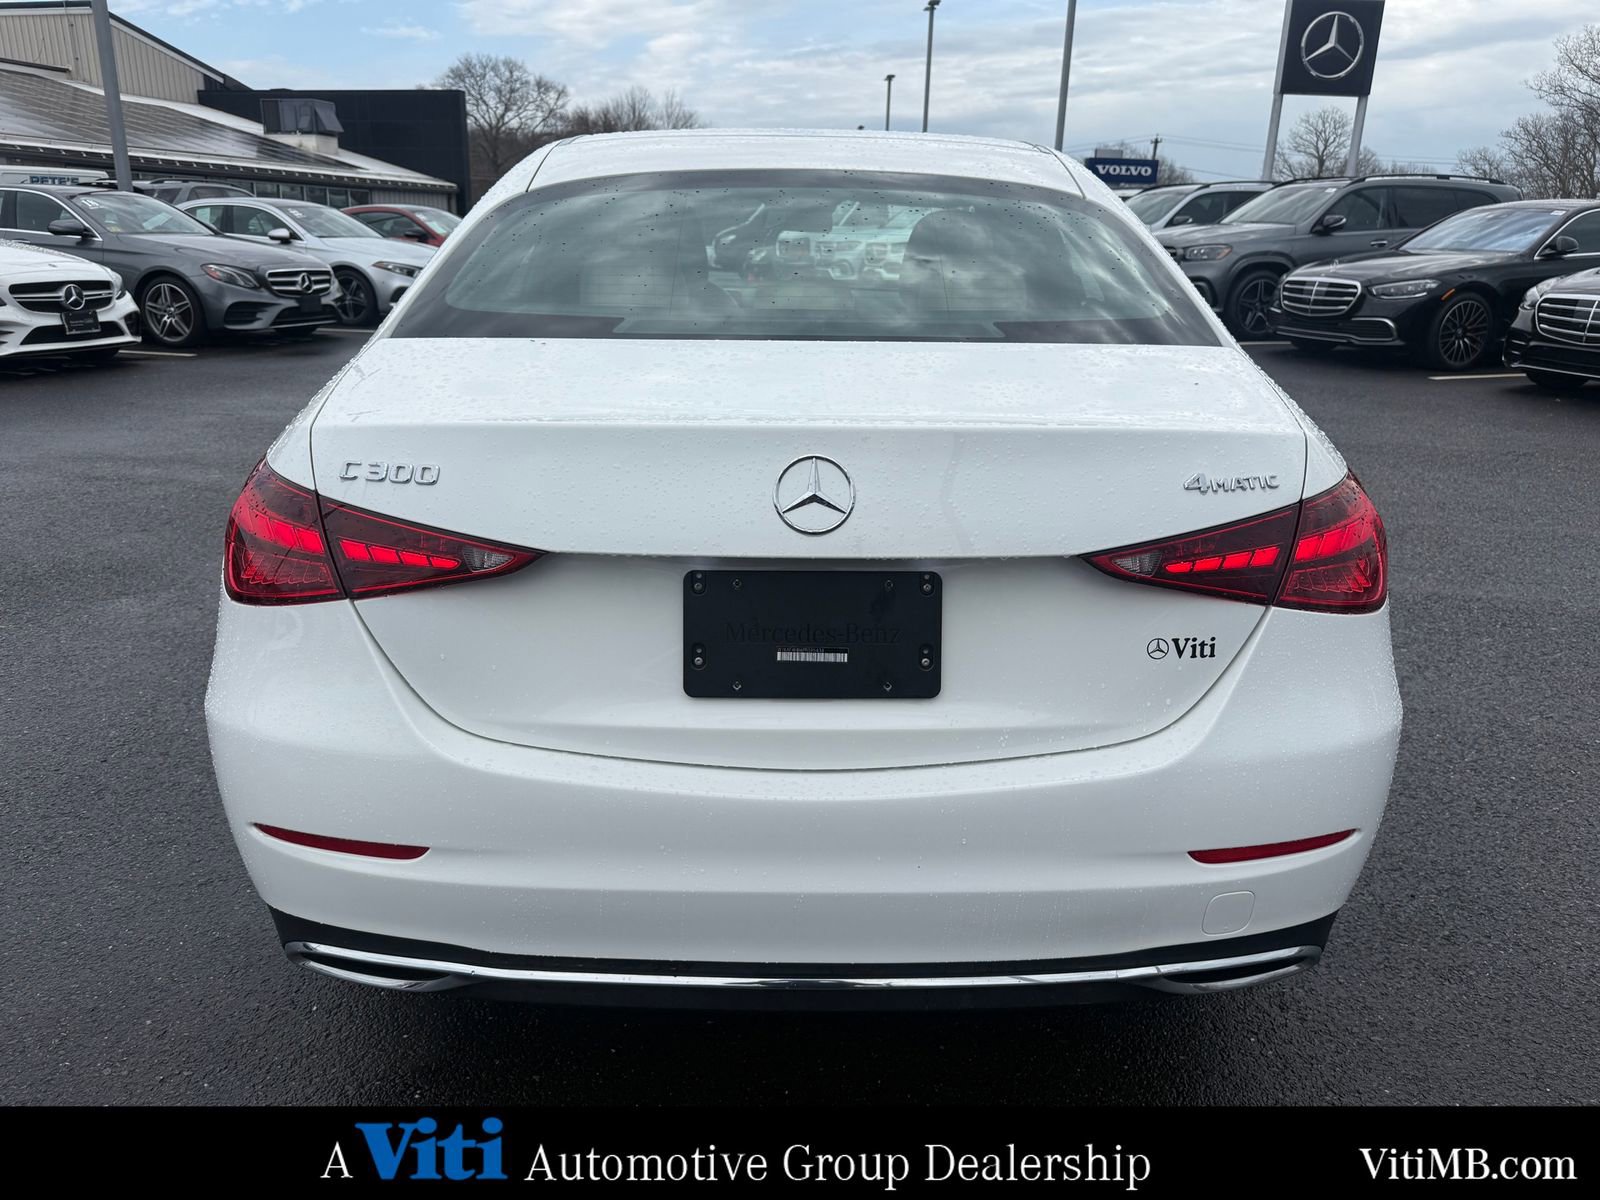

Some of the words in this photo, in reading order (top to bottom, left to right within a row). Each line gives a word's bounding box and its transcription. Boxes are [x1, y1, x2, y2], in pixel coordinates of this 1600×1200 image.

[1096, 164, 1152, 177] VOLVO
[1184, 472, 1280, 493] 4MATIC
[724, 622, 902, 644] Mercedes-Benz
[1171, 636, 1217, 659] Viti
